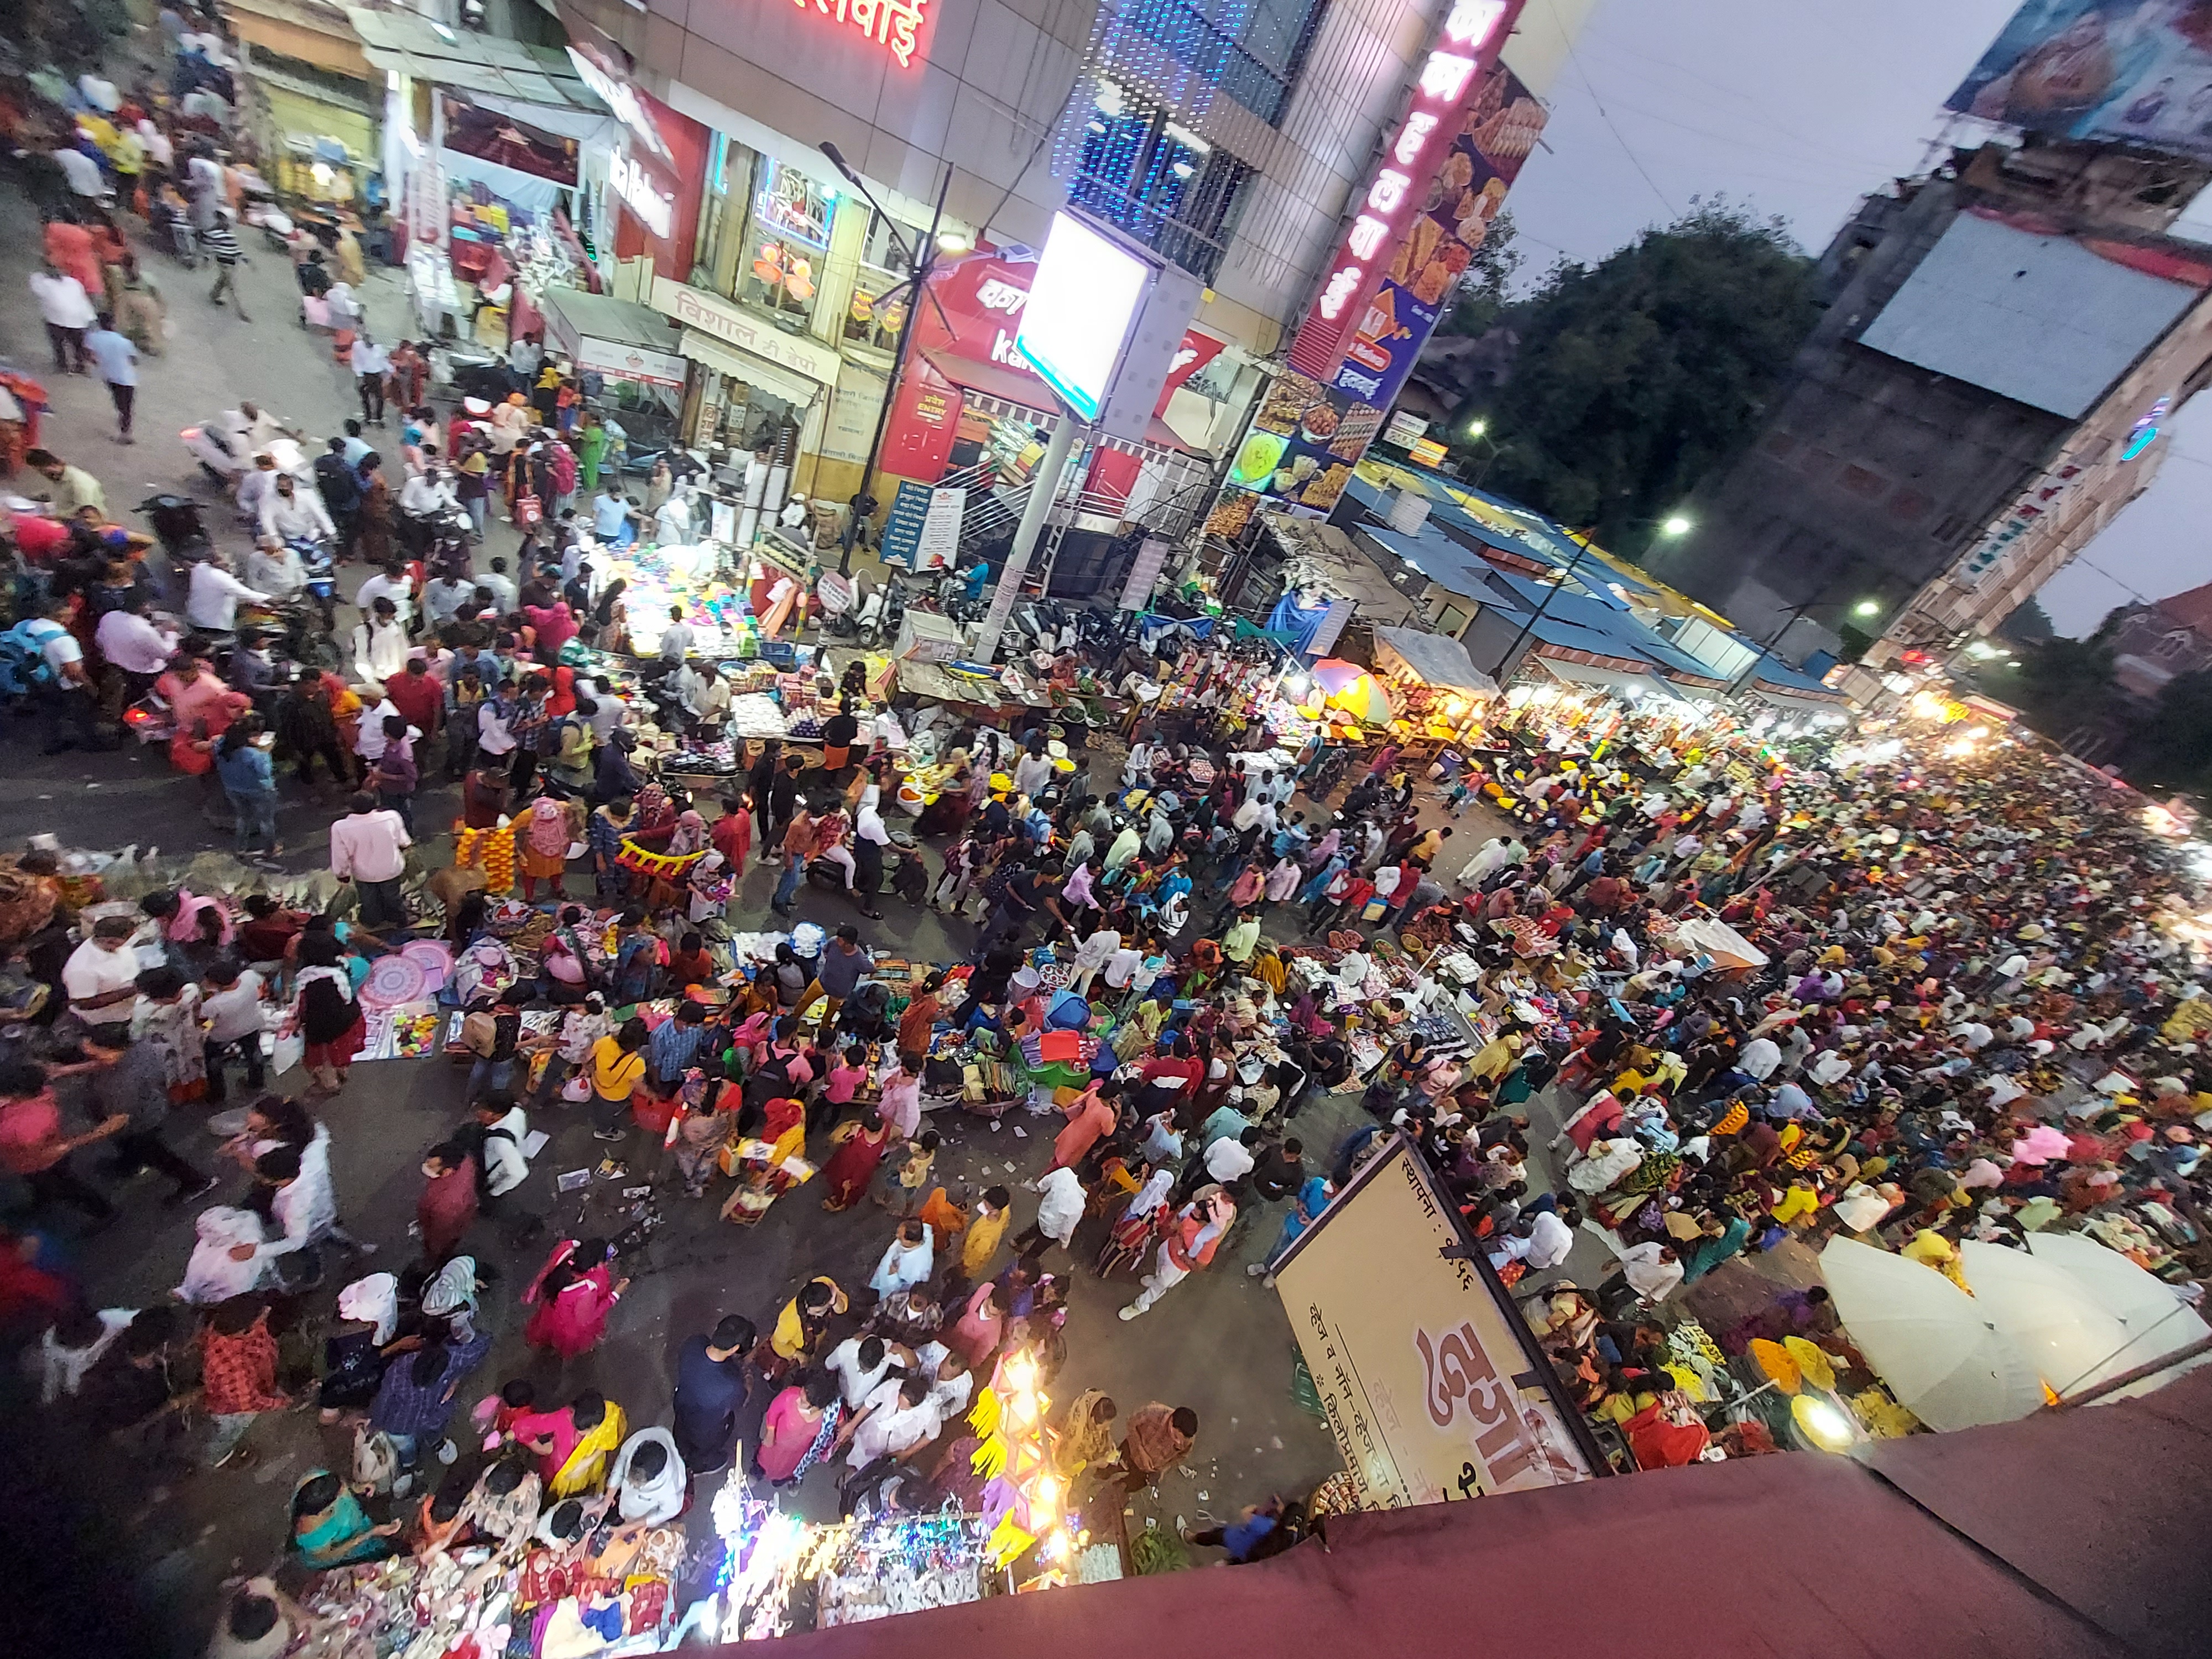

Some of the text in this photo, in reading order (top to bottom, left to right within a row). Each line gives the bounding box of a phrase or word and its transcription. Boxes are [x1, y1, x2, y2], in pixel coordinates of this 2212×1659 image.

[675, 290, 818, 375] विशाल टी डेपो
[917, 401, 948, 417] ENTRY
[924, 393, 946, 408] प्रवेश
[1400, 1157, 1438, 1219] स्थापना
[1308, 1302, 1328, 1342] व्हेज
[1325, 1345, 1337, 1360] व
